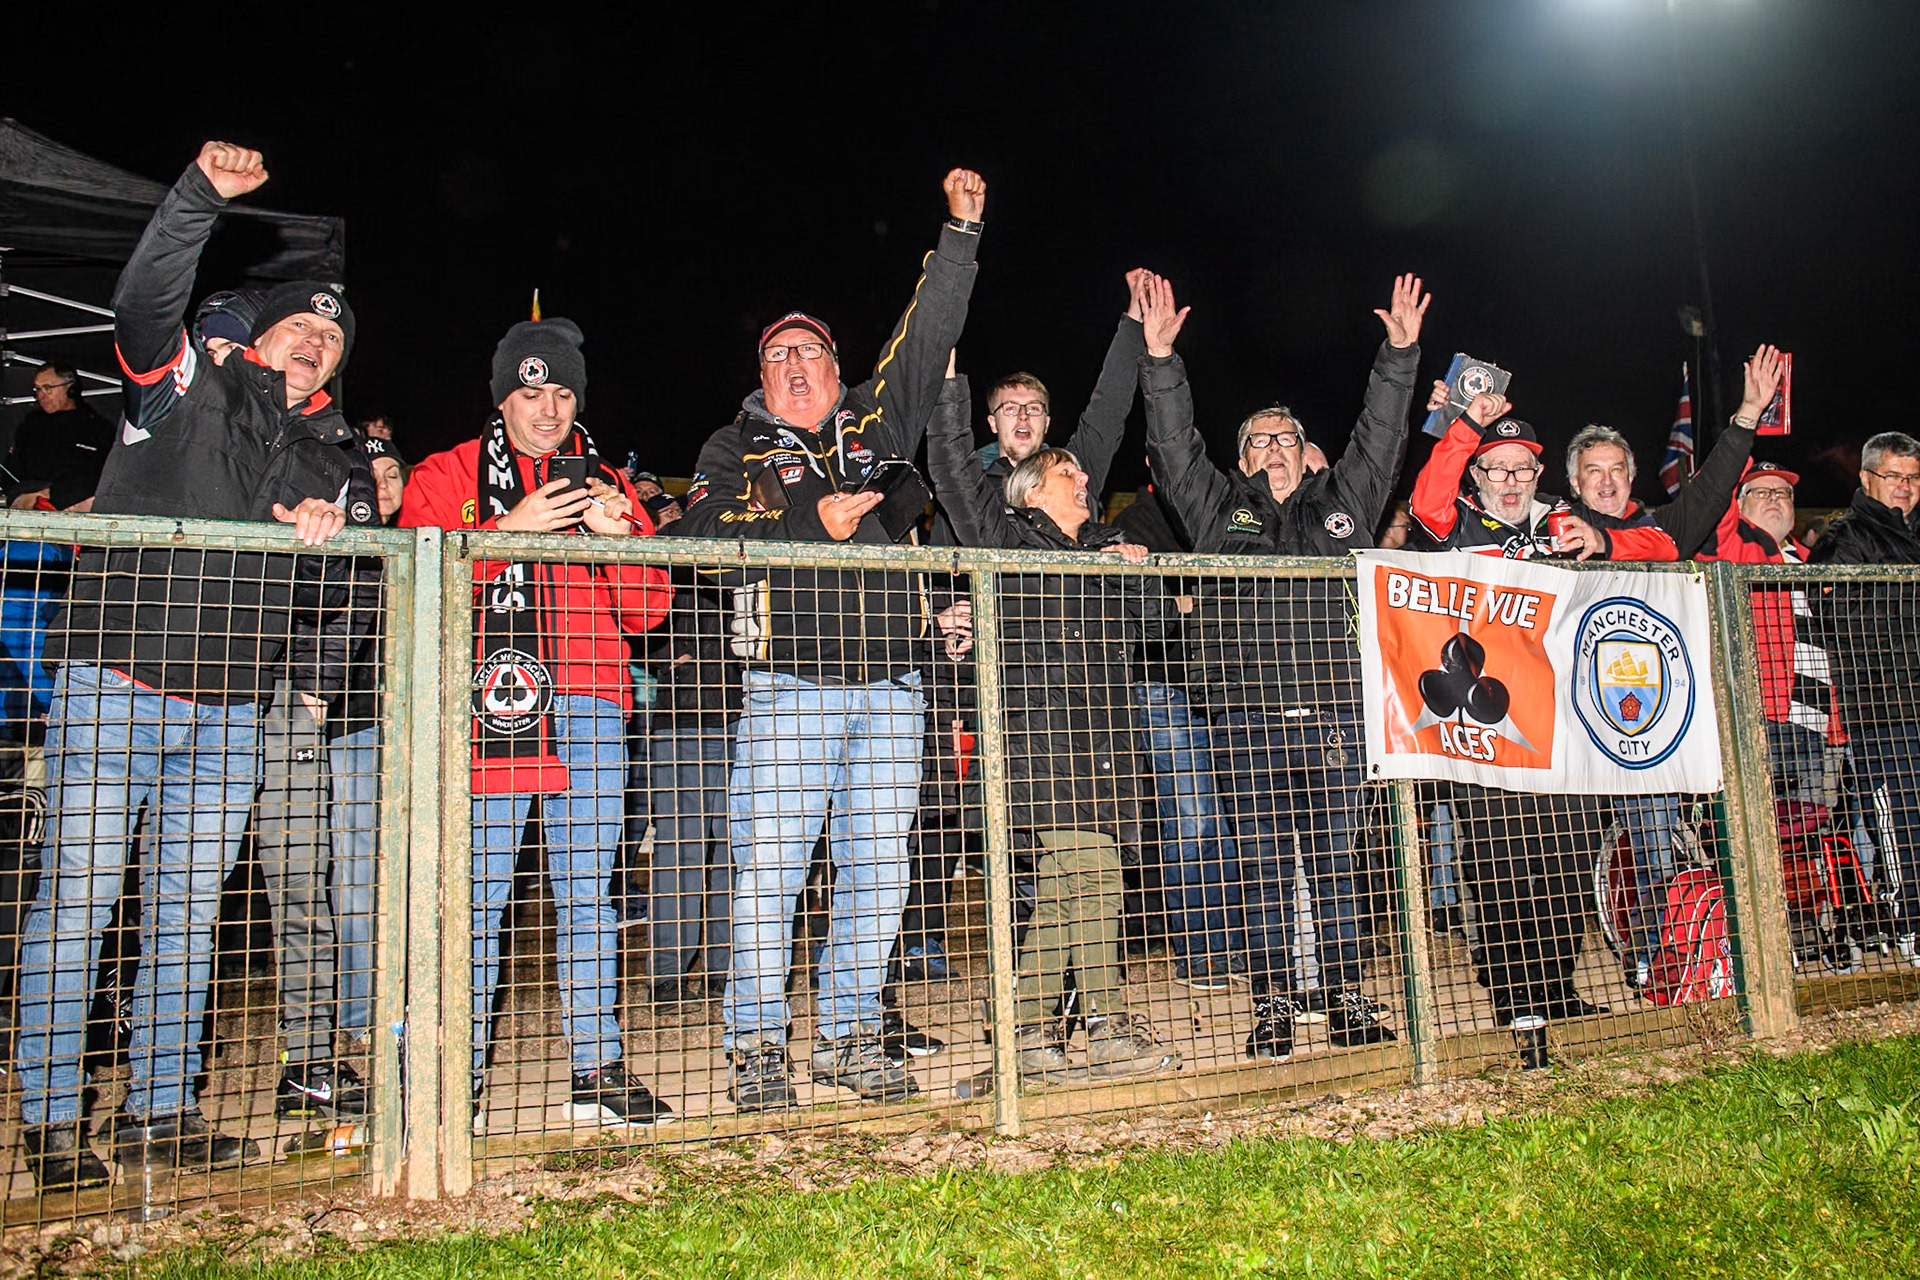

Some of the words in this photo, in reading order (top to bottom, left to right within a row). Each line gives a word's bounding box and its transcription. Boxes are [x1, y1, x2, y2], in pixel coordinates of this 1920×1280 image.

[1387, 572, 1477, 621] BELLE
[1485, 588, 1540, 629] VUE
[1582, 610, 1680, 662] MANCHESTER
[1674, 678, 1686, 688] 94
[1439, 721, 1498, 762] ACES
[1619, 740, 1651, 756] CITY
